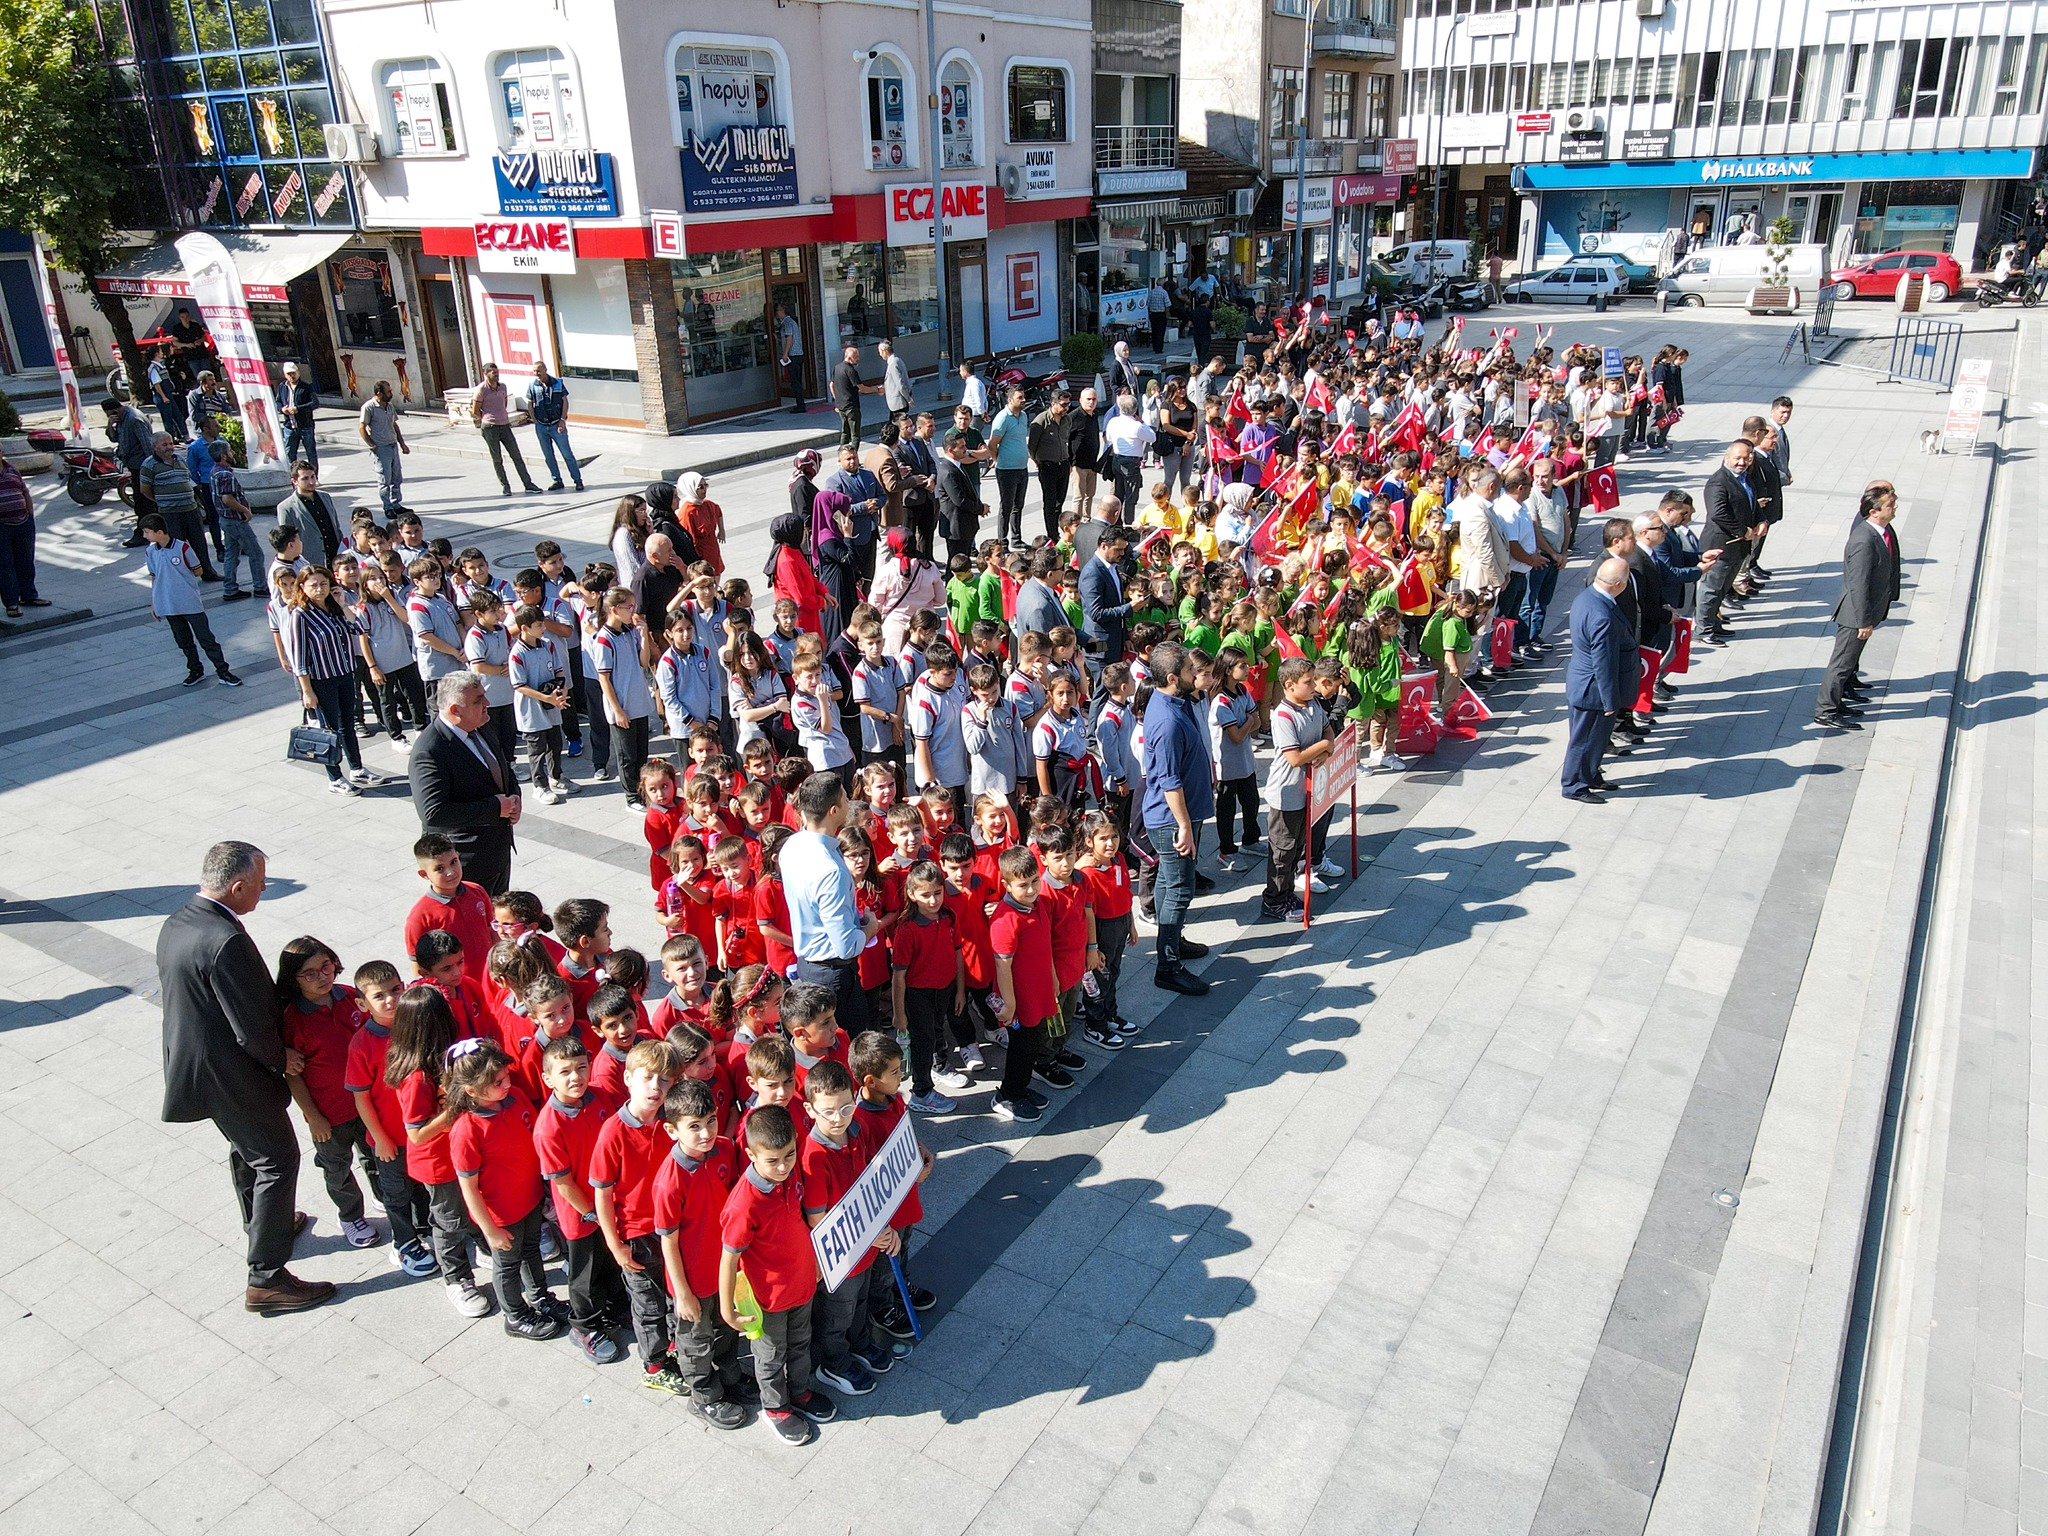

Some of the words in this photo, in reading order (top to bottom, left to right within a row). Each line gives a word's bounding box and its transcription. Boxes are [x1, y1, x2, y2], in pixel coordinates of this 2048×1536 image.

[709, 53, 748, 67] GENERALI
[733, 127, 790, 161] MUMCU
[538, 149, 597, 184] MUMCU
[1026, 151, 1053, 167] AVUKAT
[1722, 160, 1813, 178] HALKBANK
[274, 170, 302, 218] KUYU
[1308, 186, 1326, 197] MEYDAN
[1349, 182, 1374, 197] vodafone
[893, 185, 985, 222] ECZANE
[474, 222, 570, 251] ECZANE
[660, 224, 676, 250] E
[929, 222, 953, 238] EİM
[513, 253, 539, 267] EKİM
[1013, 261, 1035, 311] E
[494, 304, 534, 366] E
[820, 1202, 866, 1272] FATİH
[859, 1125, 917, 1223] İLKOKULU
